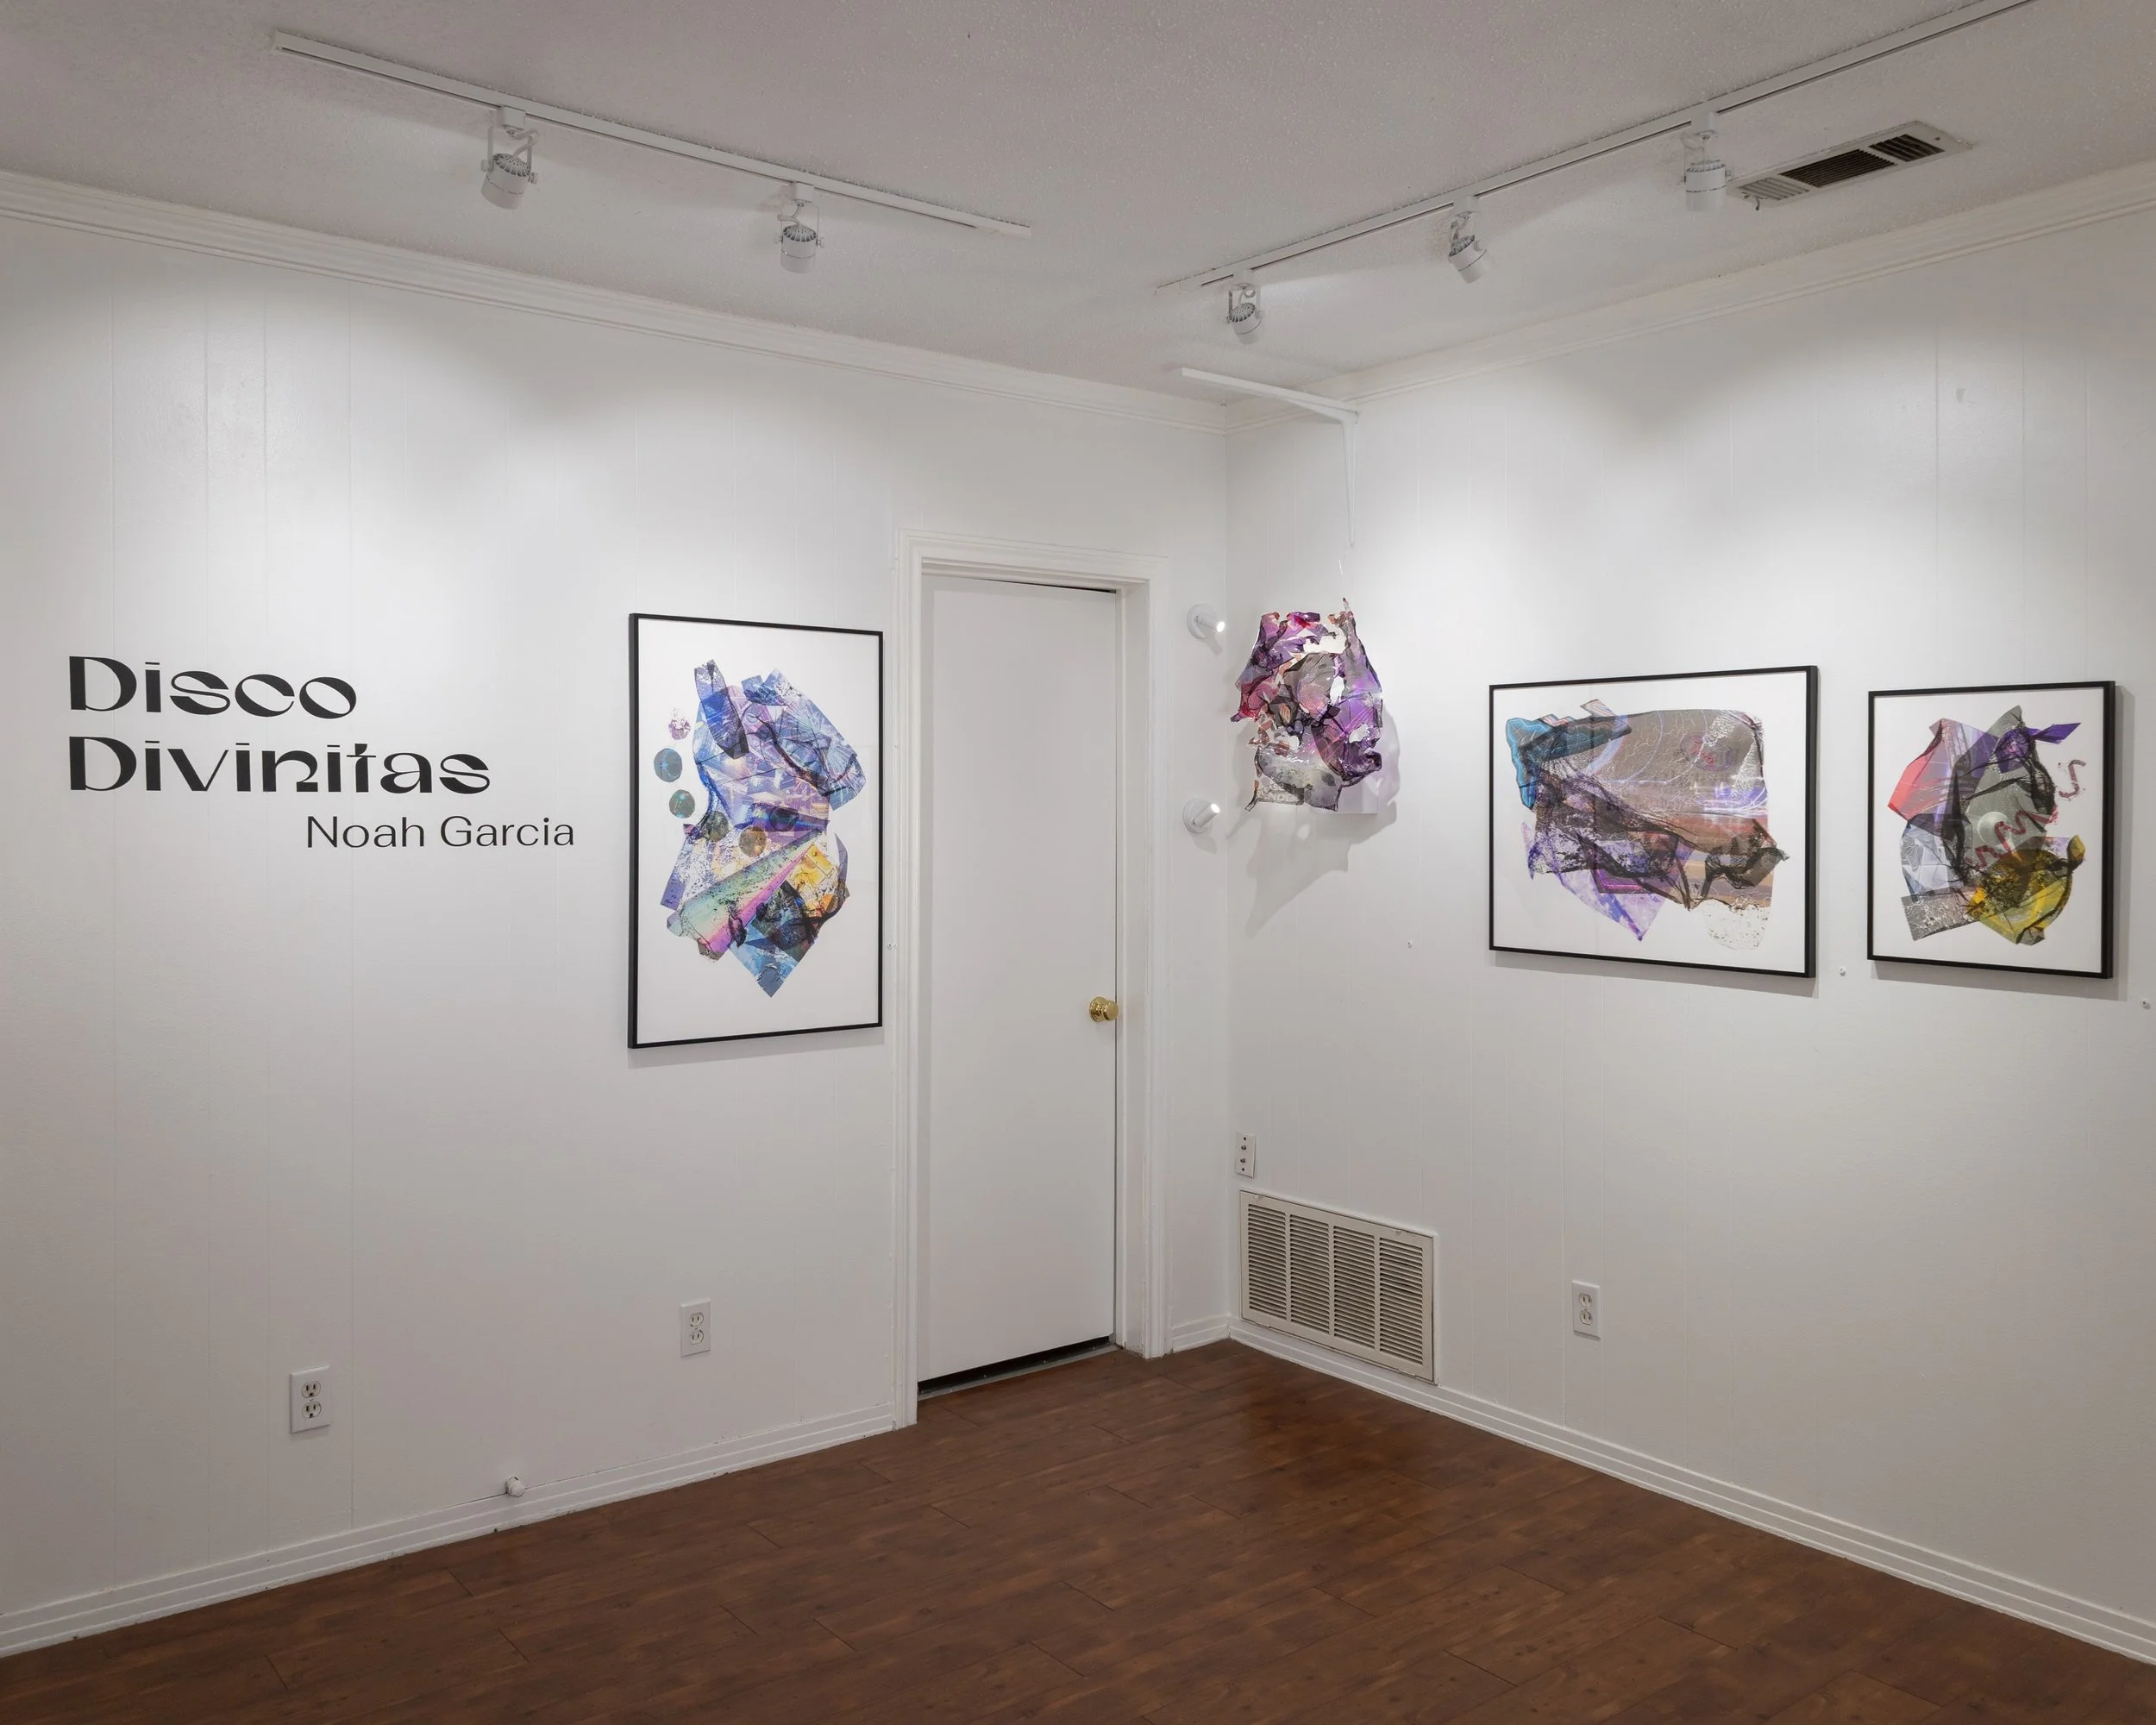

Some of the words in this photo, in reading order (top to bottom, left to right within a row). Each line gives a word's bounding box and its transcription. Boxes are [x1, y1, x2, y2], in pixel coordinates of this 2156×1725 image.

[68, 656, 357, 719] Disco
[68, 736, 492, 794] Divinitas
[307, 815, 425, 848] Noah
[440, 815, 575, 847] Garcia
